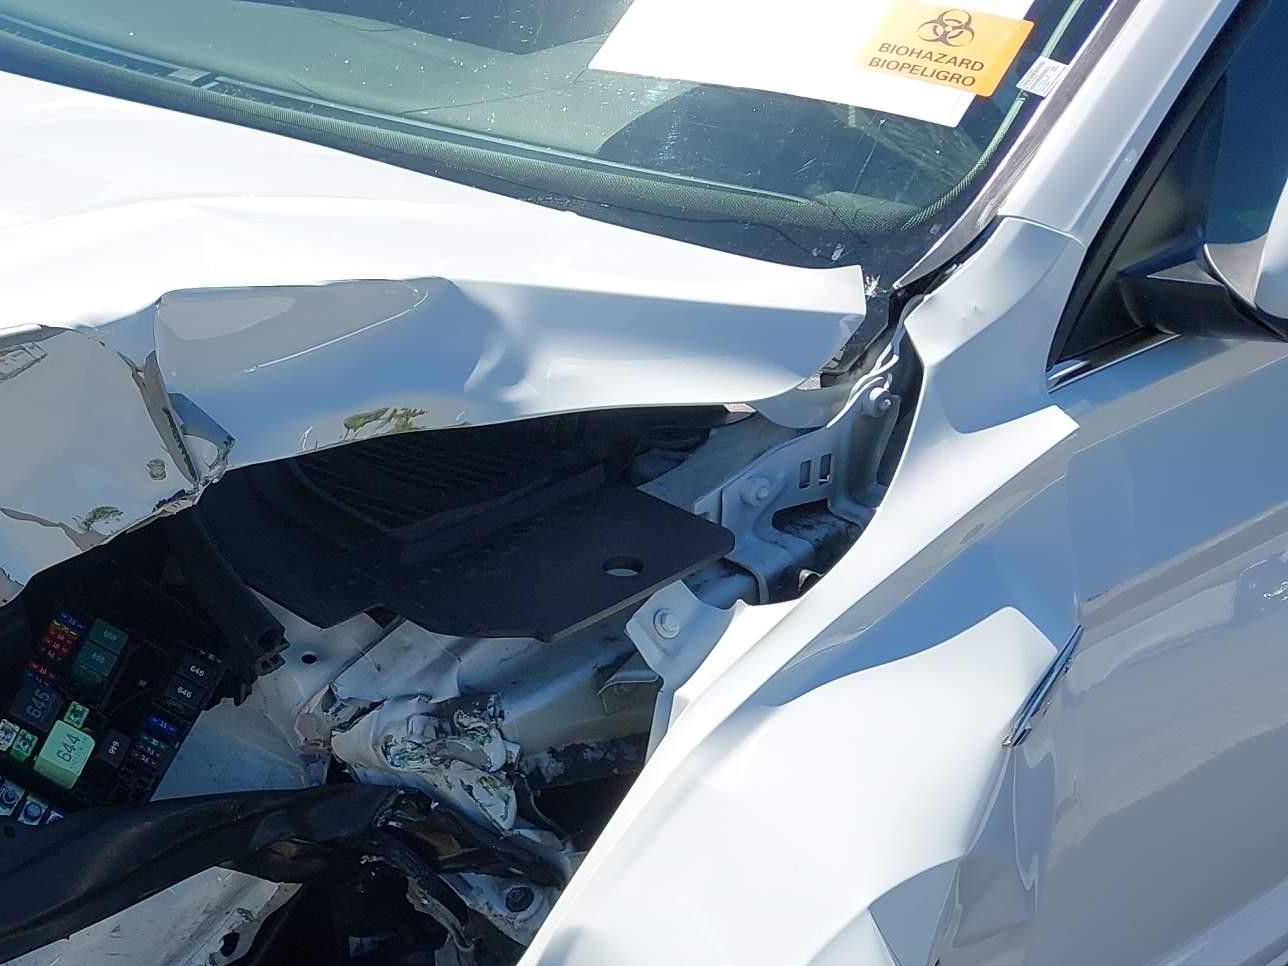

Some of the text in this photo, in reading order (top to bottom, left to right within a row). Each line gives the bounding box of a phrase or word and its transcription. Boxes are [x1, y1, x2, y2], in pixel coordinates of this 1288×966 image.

[868, 56, 977, 88] BIOPELIGRO
[877, 41, 985, 73] BIOHAZARD
[26, 688, 49, 719] 645
[56, 733, 80, 762] 644
